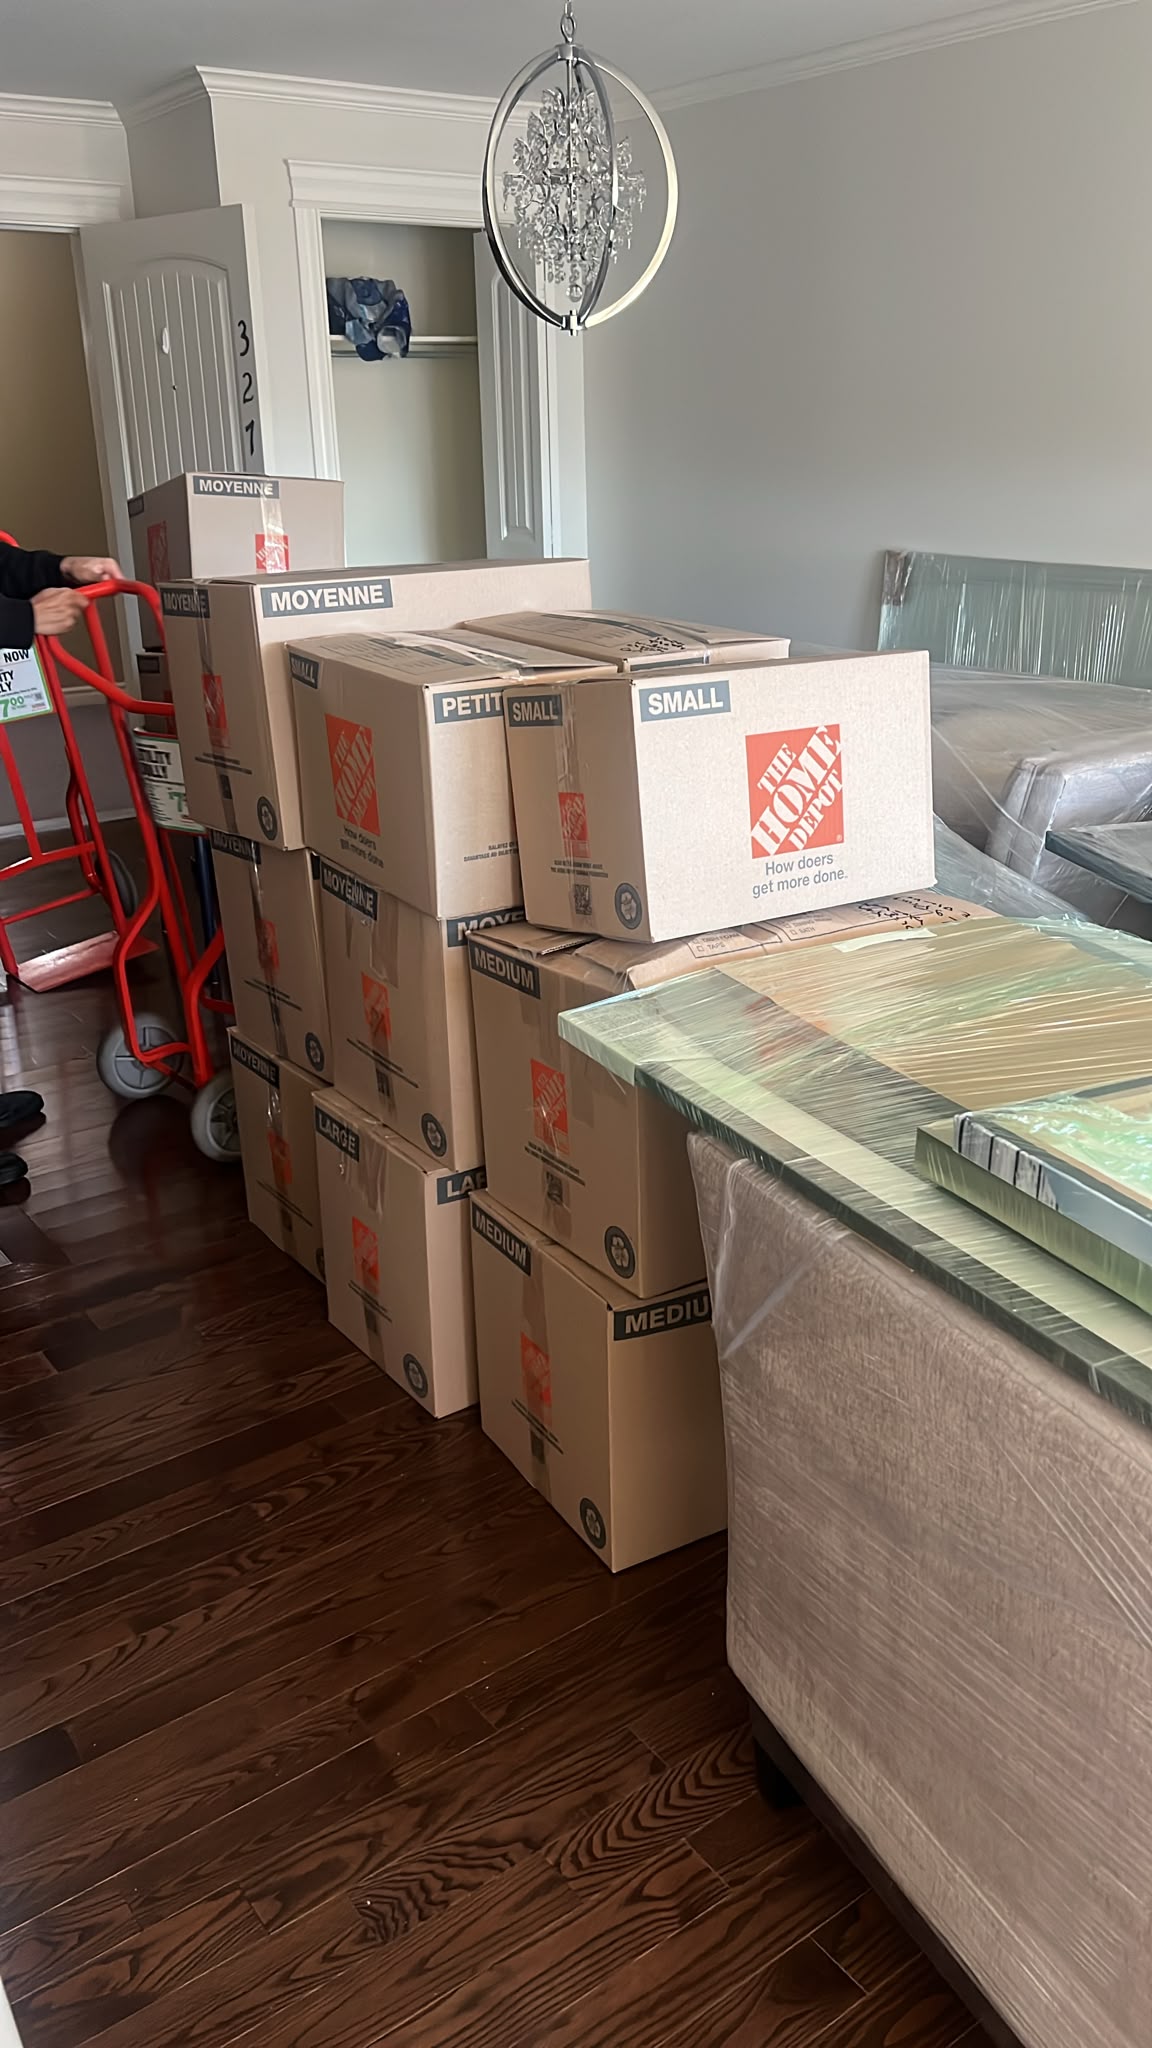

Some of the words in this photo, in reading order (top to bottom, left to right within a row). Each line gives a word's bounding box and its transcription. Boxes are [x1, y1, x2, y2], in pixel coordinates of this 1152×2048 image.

[199, 479, 274, 496] MOYENNE
[162, 591, 208, 613] MOYENNE
[270, 584, 385, 612] MOYENNE
[3, 649, 30, 663] NOW
[512, 700, 559, 723] SMALL
[648, 687, 724, 716] SMALL
[757, 742, 797, 796] THE
[750, 725, 843, 857] HOME
[787, 768, 844, 851] DEPOT
[764, 860, 794, 876] How
[797, 853, 834, 871] doers
[322, 867, 374, 913] MOYENNE
[752, 880, 774, 898] get
[777, 875, 810, 892] more
[813, 868, 849, 885] done.
[474, 946, 535, 991] MEDIUM
[318, 1113, 356, 1154] LARGE
[475, 1210, 527, 1267] MEDIUM
[625, 1295, 710, 1334] MEDIU
